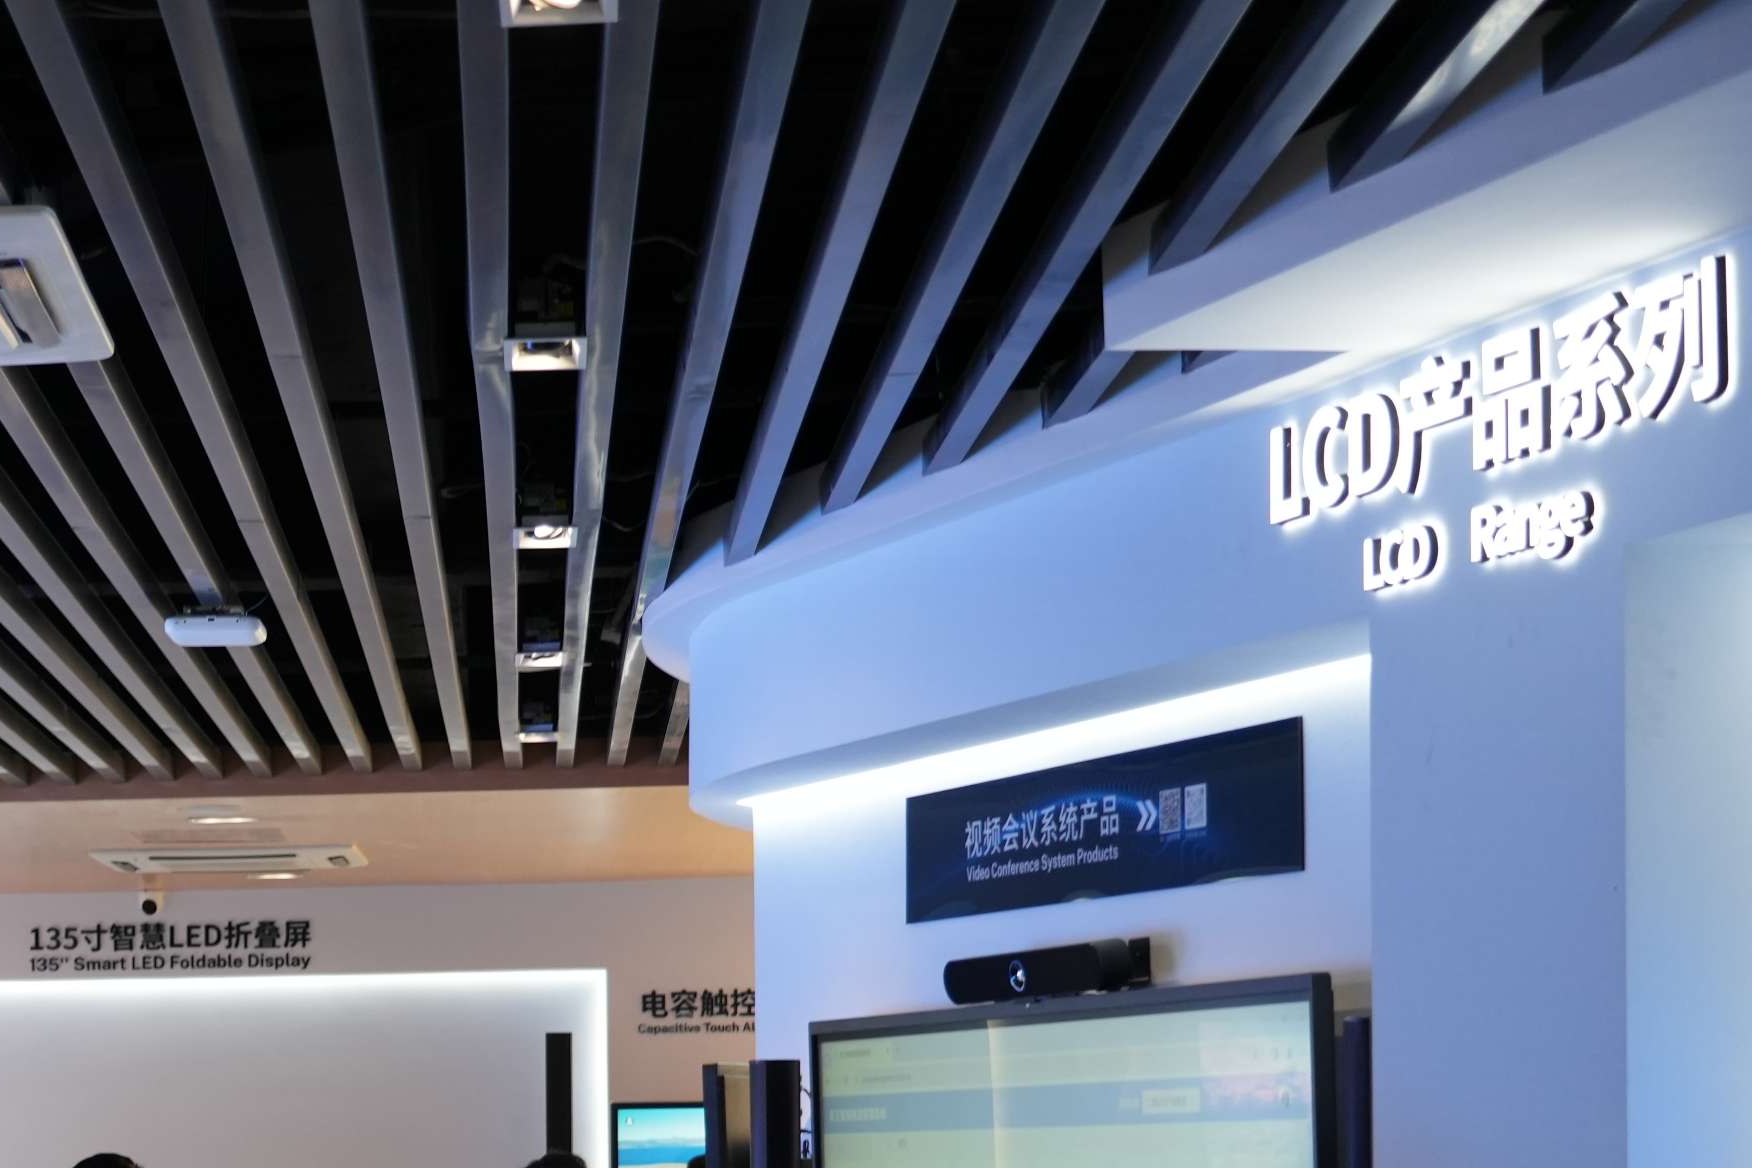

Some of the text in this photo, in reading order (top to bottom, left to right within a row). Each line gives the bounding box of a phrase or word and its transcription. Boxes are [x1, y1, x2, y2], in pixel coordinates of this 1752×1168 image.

[1269, 254, 1730, 526] LCD产品系列
[1362, 491, 1595, 592] LCD Range
[964, 795, 1120, 860] 视频会议系统产品
[966, 845, 1119, 882] Video Conference System Products
[29, 920, 311, 952] 135寸智慧LED折叠屏
[73, 956, 126, 972] Smart
[131, 954, 165, 970] LED
[169, 953, 244, 969] Foldable
[247, 951, 311, 970] Display
[641, 987, 756, 1018] 电容触控
[638, 1023, 701, 1036] Capacitive
[704, 1021, 739, 1034] Touch
